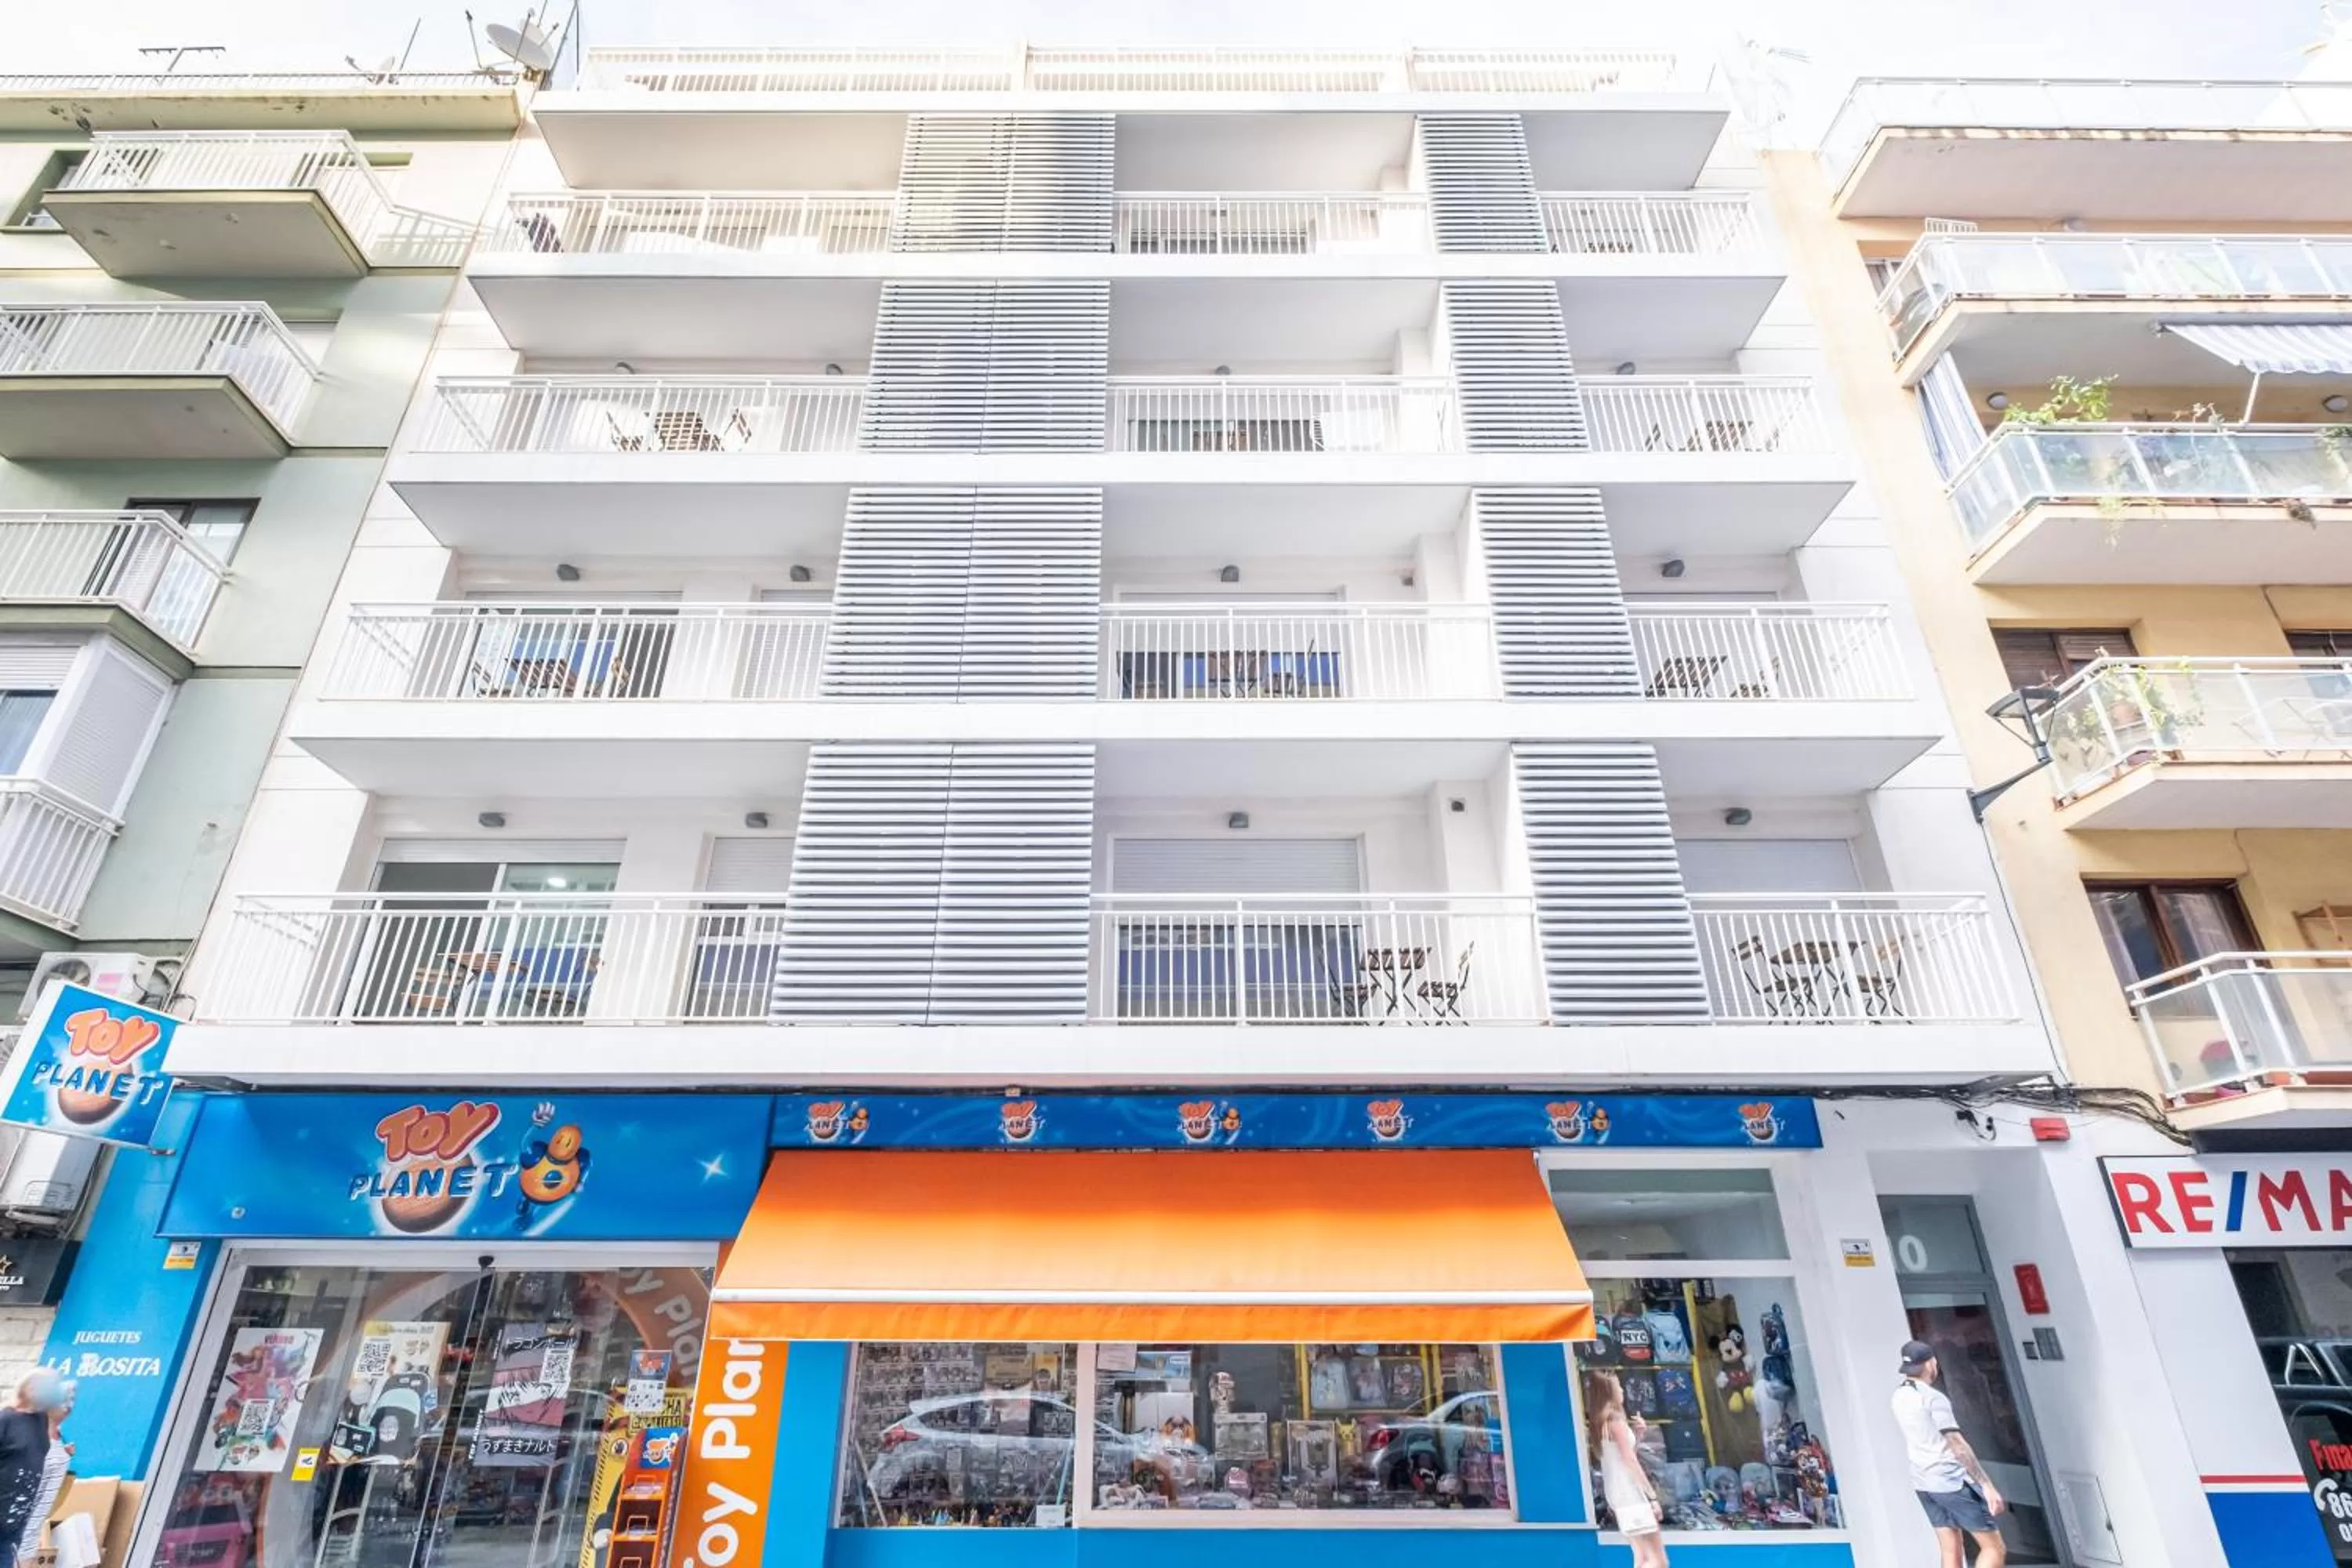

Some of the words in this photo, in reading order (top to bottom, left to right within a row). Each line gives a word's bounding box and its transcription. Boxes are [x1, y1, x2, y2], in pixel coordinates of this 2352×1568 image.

[64, 1008, 160, 1065] TOY
[32, 1061, 163, 1105] PLANET
[375, 1101, 502, 1162] TOY
[347, 1163, 519, 1200] PLANET
[72, 1330, 143, 1344] JUGUETES
[1623, 1332, 1647, 1341] NYC
[683, 1482, 758, 1568] oy
